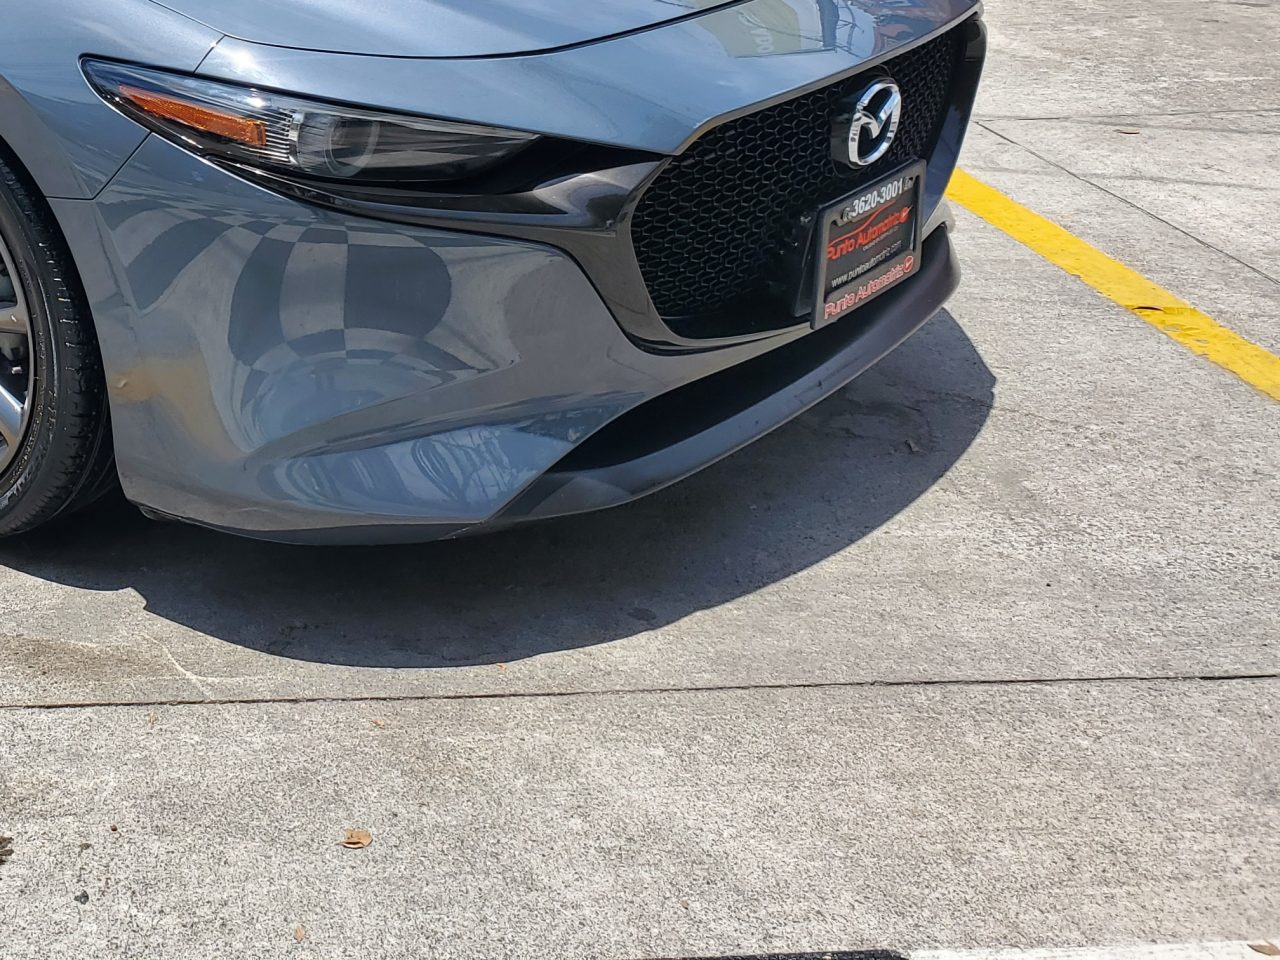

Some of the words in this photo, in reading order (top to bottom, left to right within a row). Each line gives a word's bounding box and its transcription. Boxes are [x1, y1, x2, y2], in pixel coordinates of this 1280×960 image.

[852, 177, 904, 218] 3620-3001
[827, 237, 856, 261] Punto
[823, 293, 856, 320] Punto
